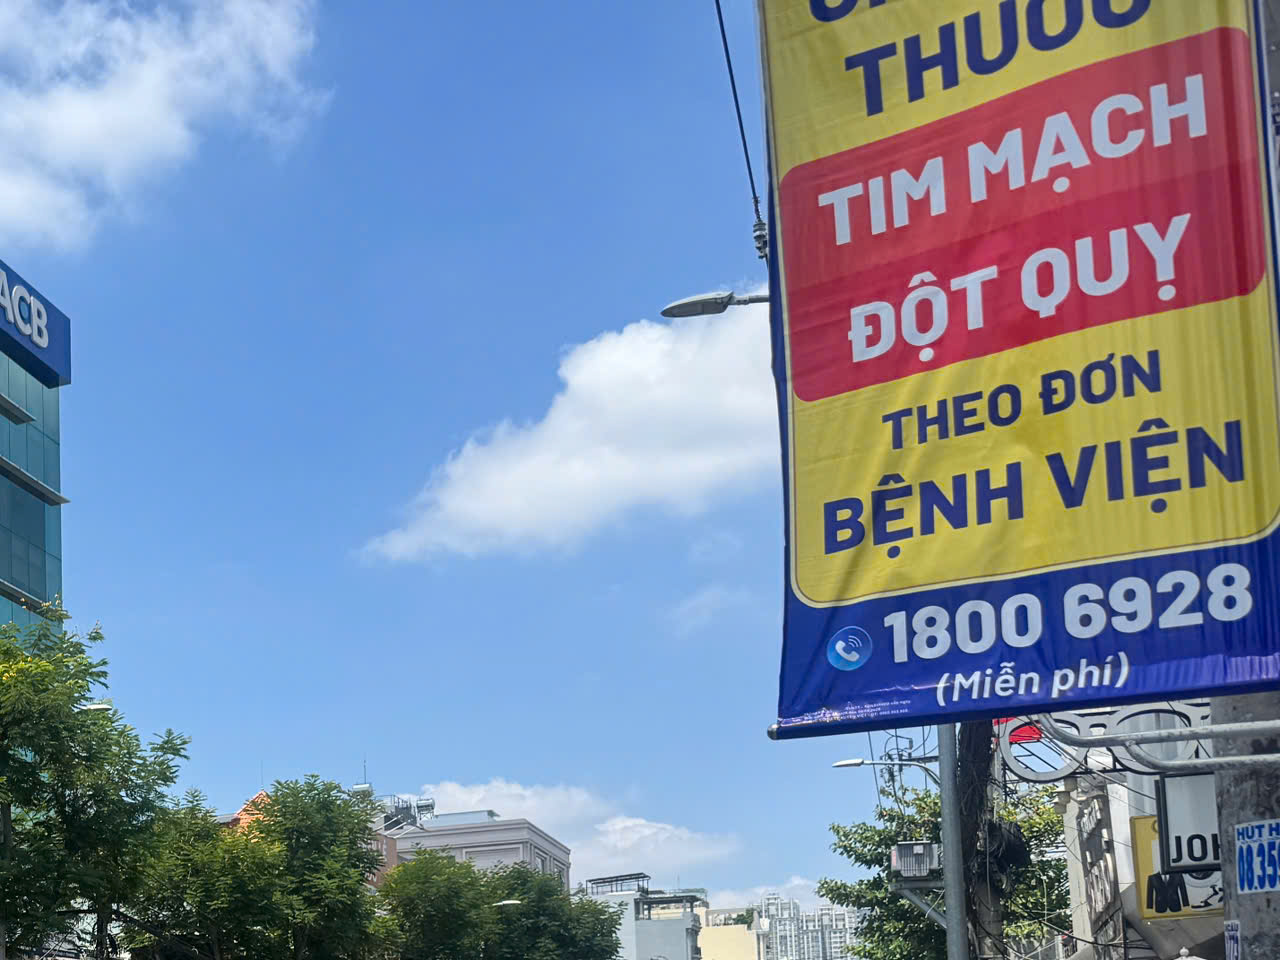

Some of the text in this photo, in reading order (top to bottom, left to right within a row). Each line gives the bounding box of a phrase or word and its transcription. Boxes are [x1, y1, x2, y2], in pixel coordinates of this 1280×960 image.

[818, 74, 1208, 246] TIM MẠCH
[848, 213, 1192, 363] ĐỘT QUỴ
[882, 349, 1162, 451] THEO ĐƠN
[824, 417, 1245, 560] BỆNH VIỆN
[883, 563, 1253, 664] 1800 6928
[935, 651, 1130, 706] (Miễn phí)
